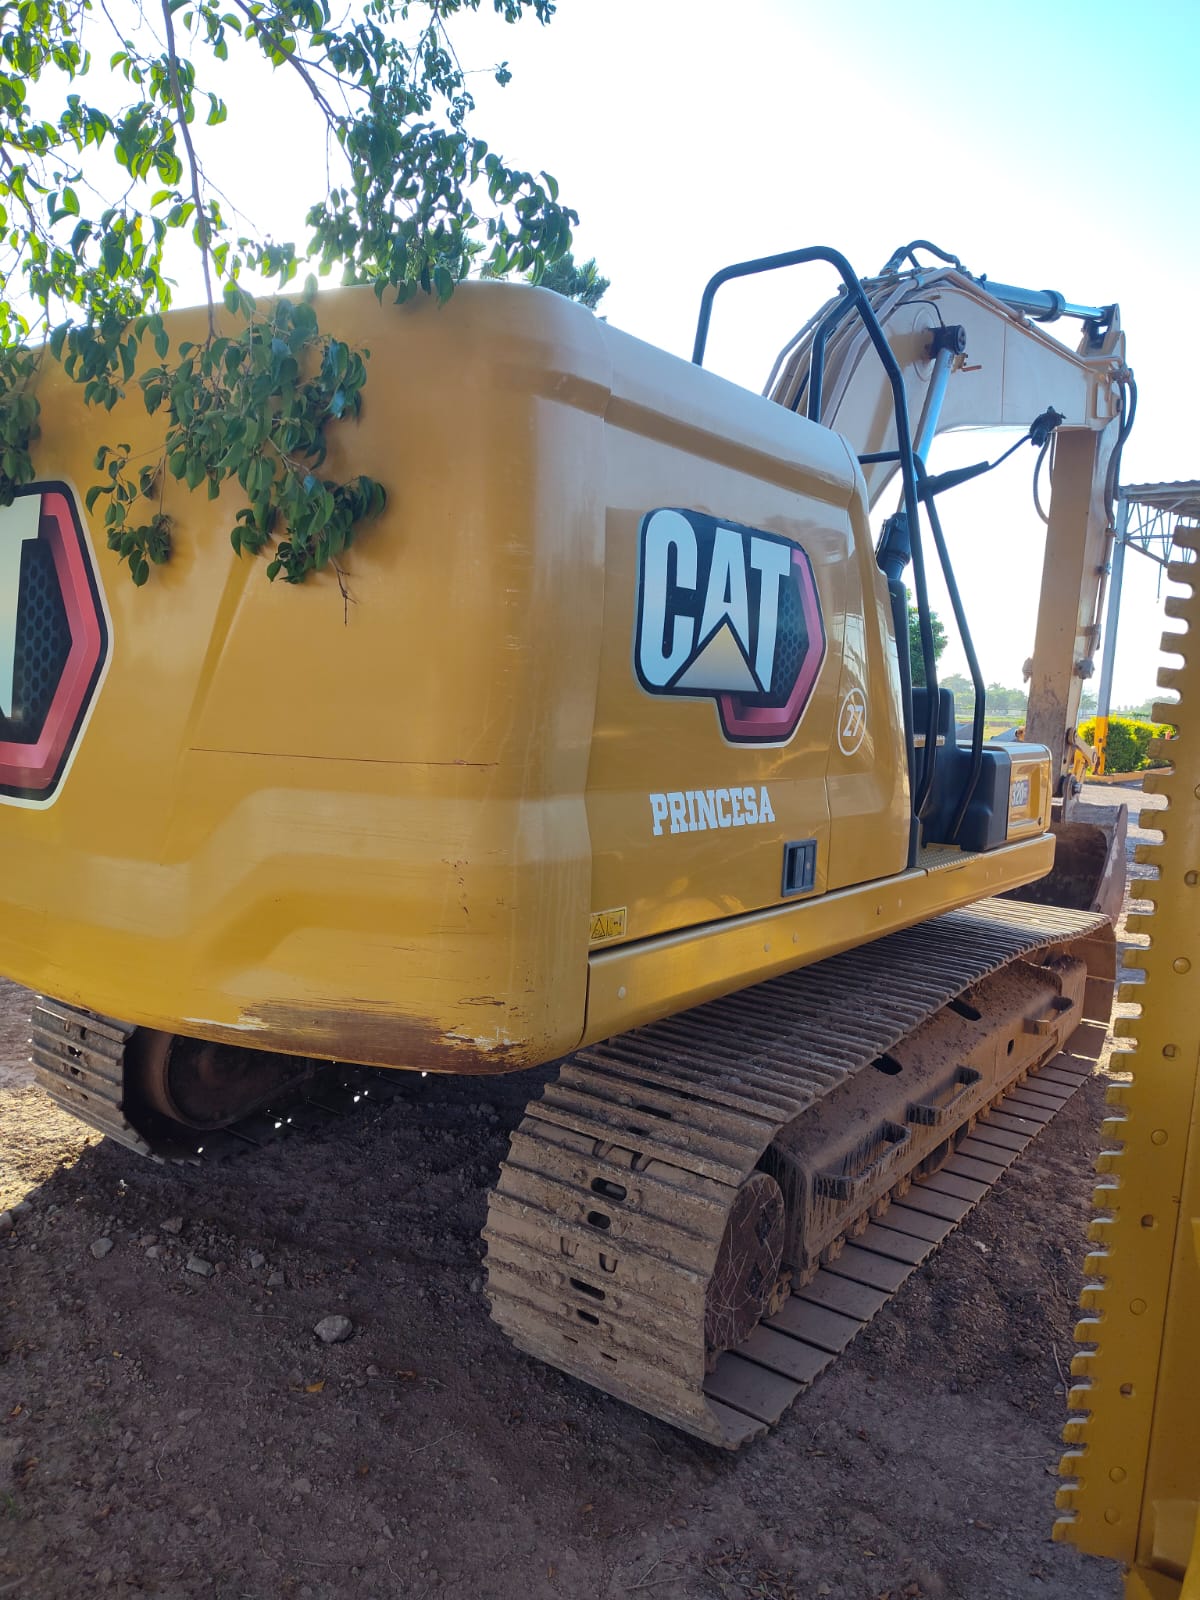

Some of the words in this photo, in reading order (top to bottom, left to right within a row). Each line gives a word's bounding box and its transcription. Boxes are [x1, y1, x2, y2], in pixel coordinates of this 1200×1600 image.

[640, 510, 791, 693] CAT
[843, 704, 864, 737] 27
[650, 786, 775, 836] PRINCESA
